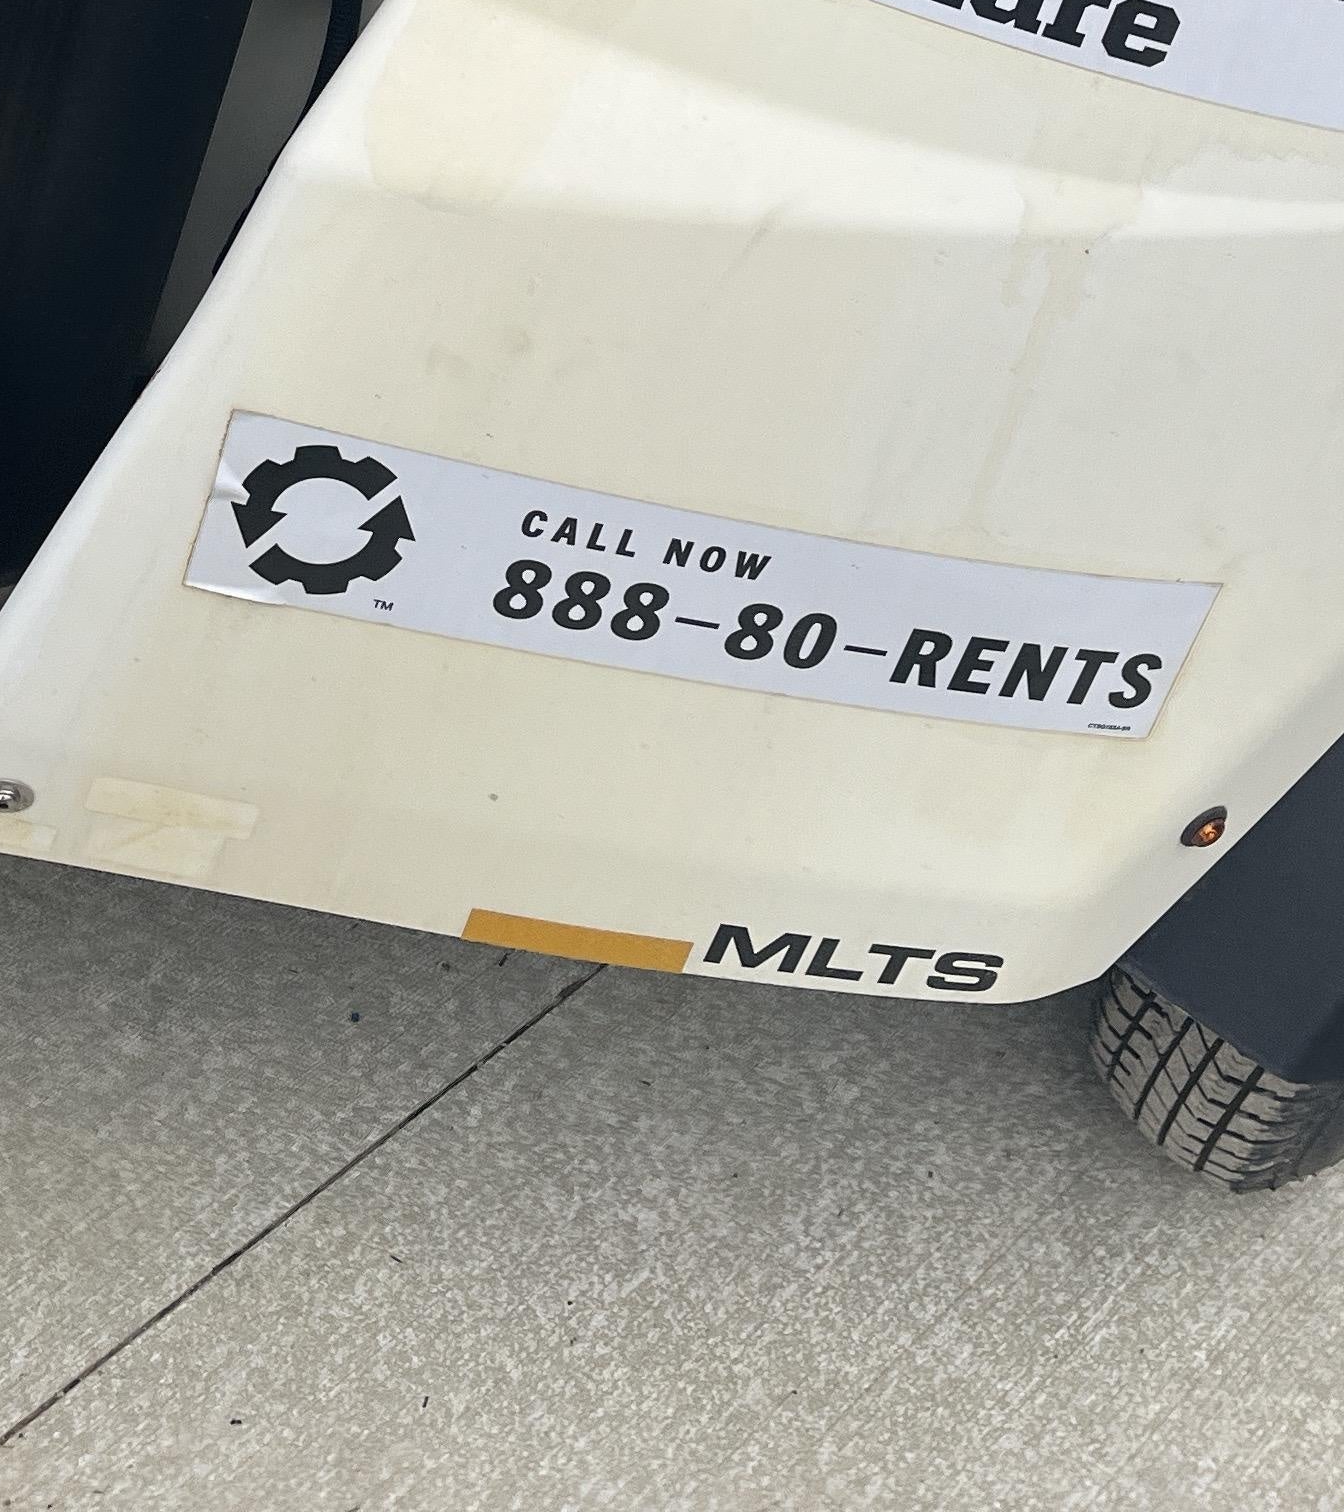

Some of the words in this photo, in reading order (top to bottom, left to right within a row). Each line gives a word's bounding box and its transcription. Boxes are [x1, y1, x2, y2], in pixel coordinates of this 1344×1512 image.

[521, 509, 637, 559] CALL
[663, 537, 772, 581] NOW
[373, 599, 394, 611] TM
[702, 922, 1005, 993] MLTS
